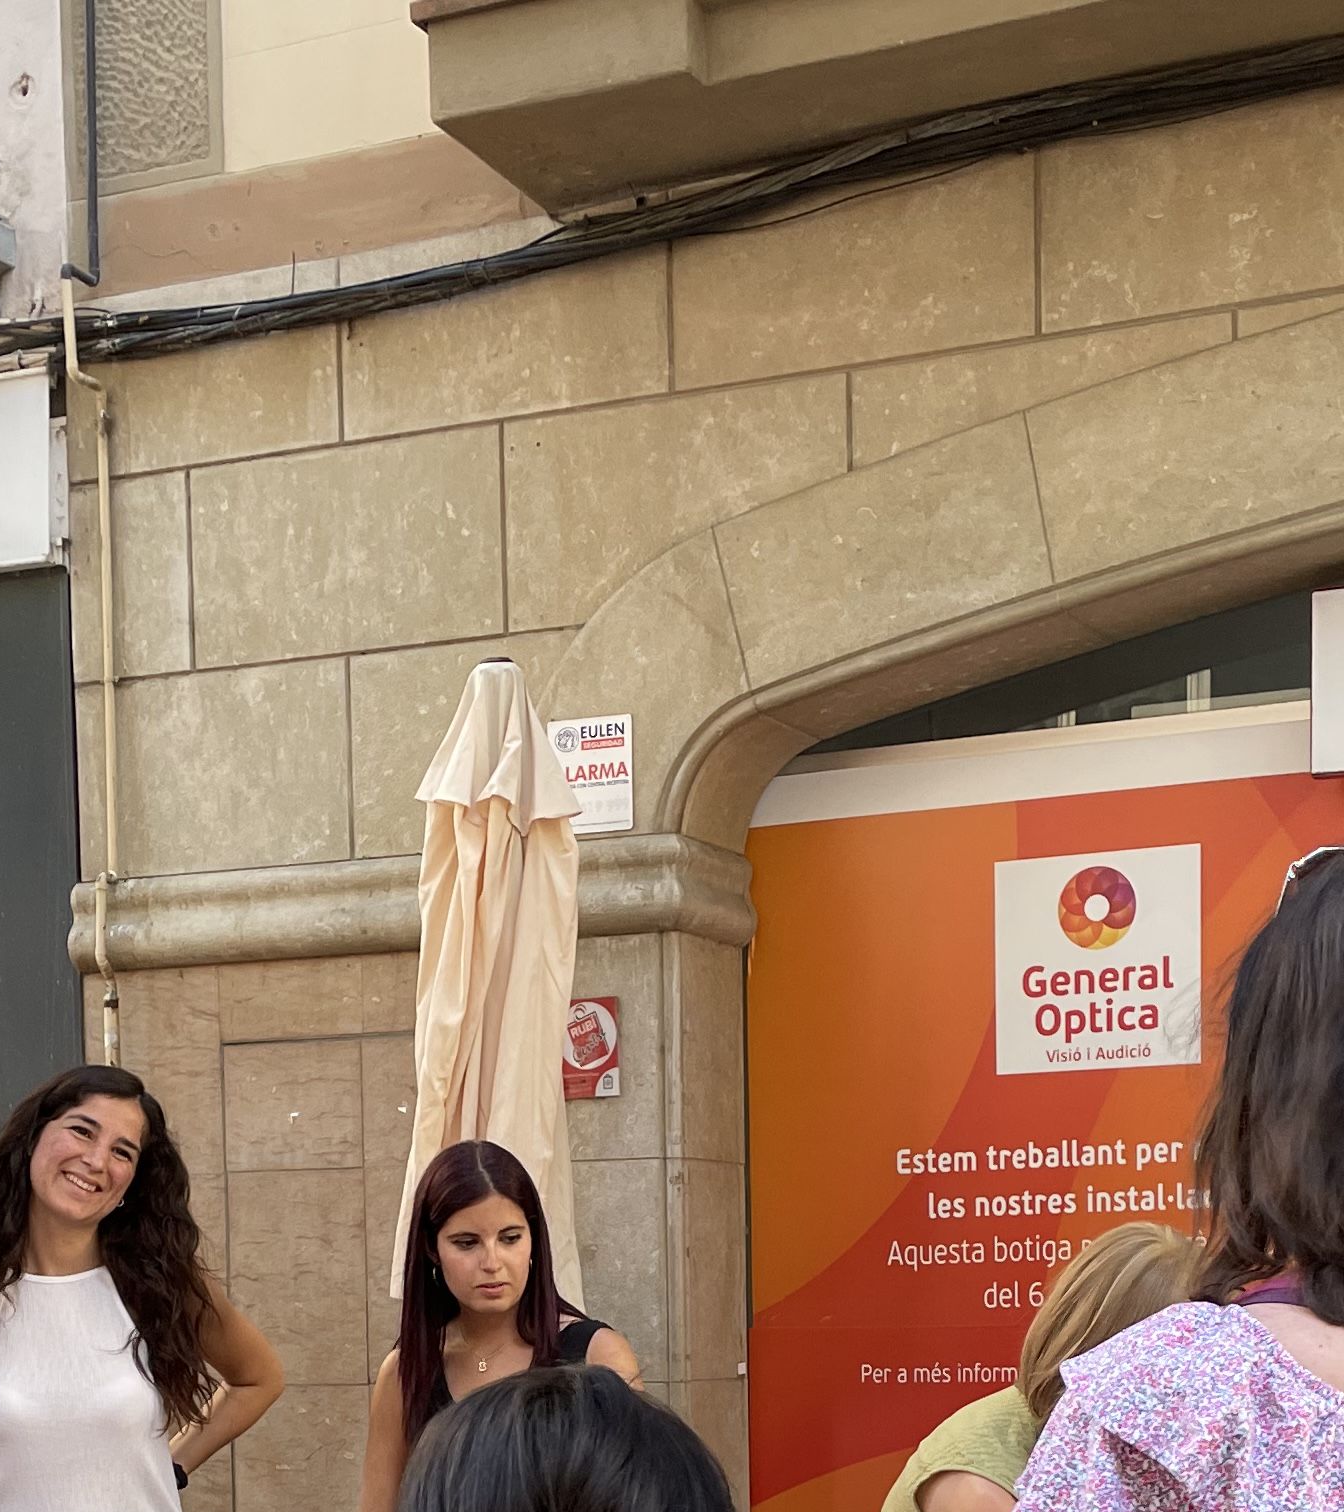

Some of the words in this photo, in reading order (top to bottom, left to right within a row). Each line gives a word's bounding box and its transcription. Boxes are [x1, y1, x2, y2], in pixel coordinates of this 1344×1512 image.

[581, 722, 624, 739] EULEN
[1022, 956, 1174, 998] General
[1035, 998, 1158, 1043] Optica
[1046, 1047, 1082, 1063] Visió
[1087, 1047, 1091, 1060] i
[1096, 1043, 1151, 1060] Audició
[896, 1149, 977, 1175] Estem
[986, 1139, 1126, 1170] treballant
[1136, 1141, 1183, 1171] per
[929, 1192, 966, 1219] les
[975, 1190, 1077, 1217] nostres
[888, 1239, 985, 1271] Aquesta
[994, 1235, 1072, 1268] botiga
[984, 1280, 1021, 1308] del
[861, 1364, 892, 1383] Per
[897, 1368, 908, 1383] a
[913, 1362, 951, 1383] més
